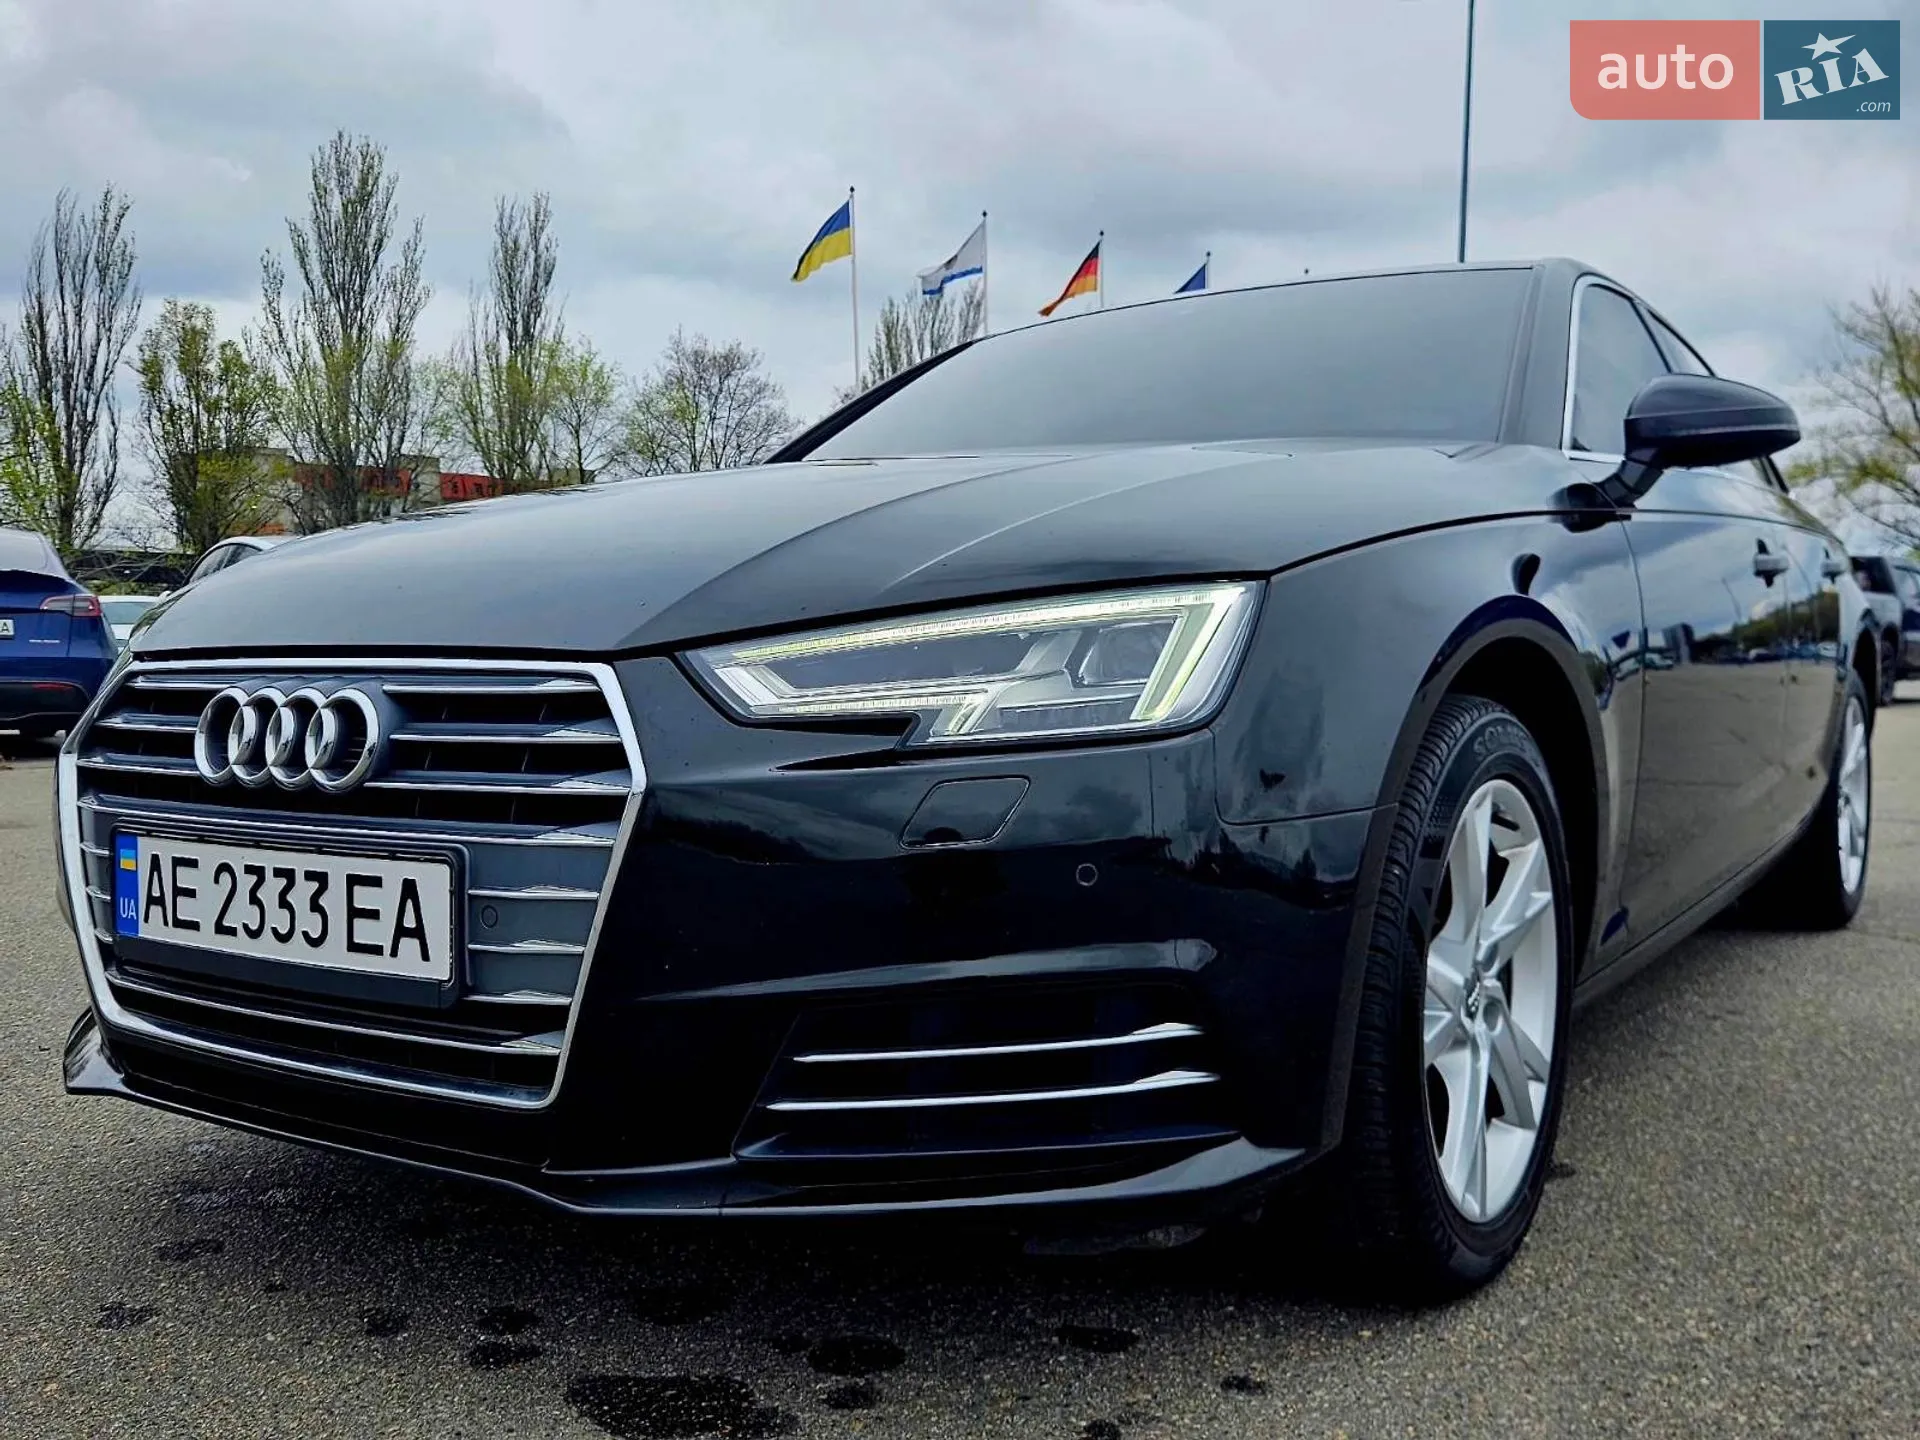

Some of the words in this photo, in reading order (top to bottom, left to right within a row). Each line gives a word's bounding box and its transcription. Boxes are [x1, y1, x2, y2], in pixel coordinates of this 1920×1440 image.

[119, 896, 137, 920] UA
[143, 853, 201, 932] AE
[213, 862, 329, 948] 2333
[345, 873, 430, 962] EA
